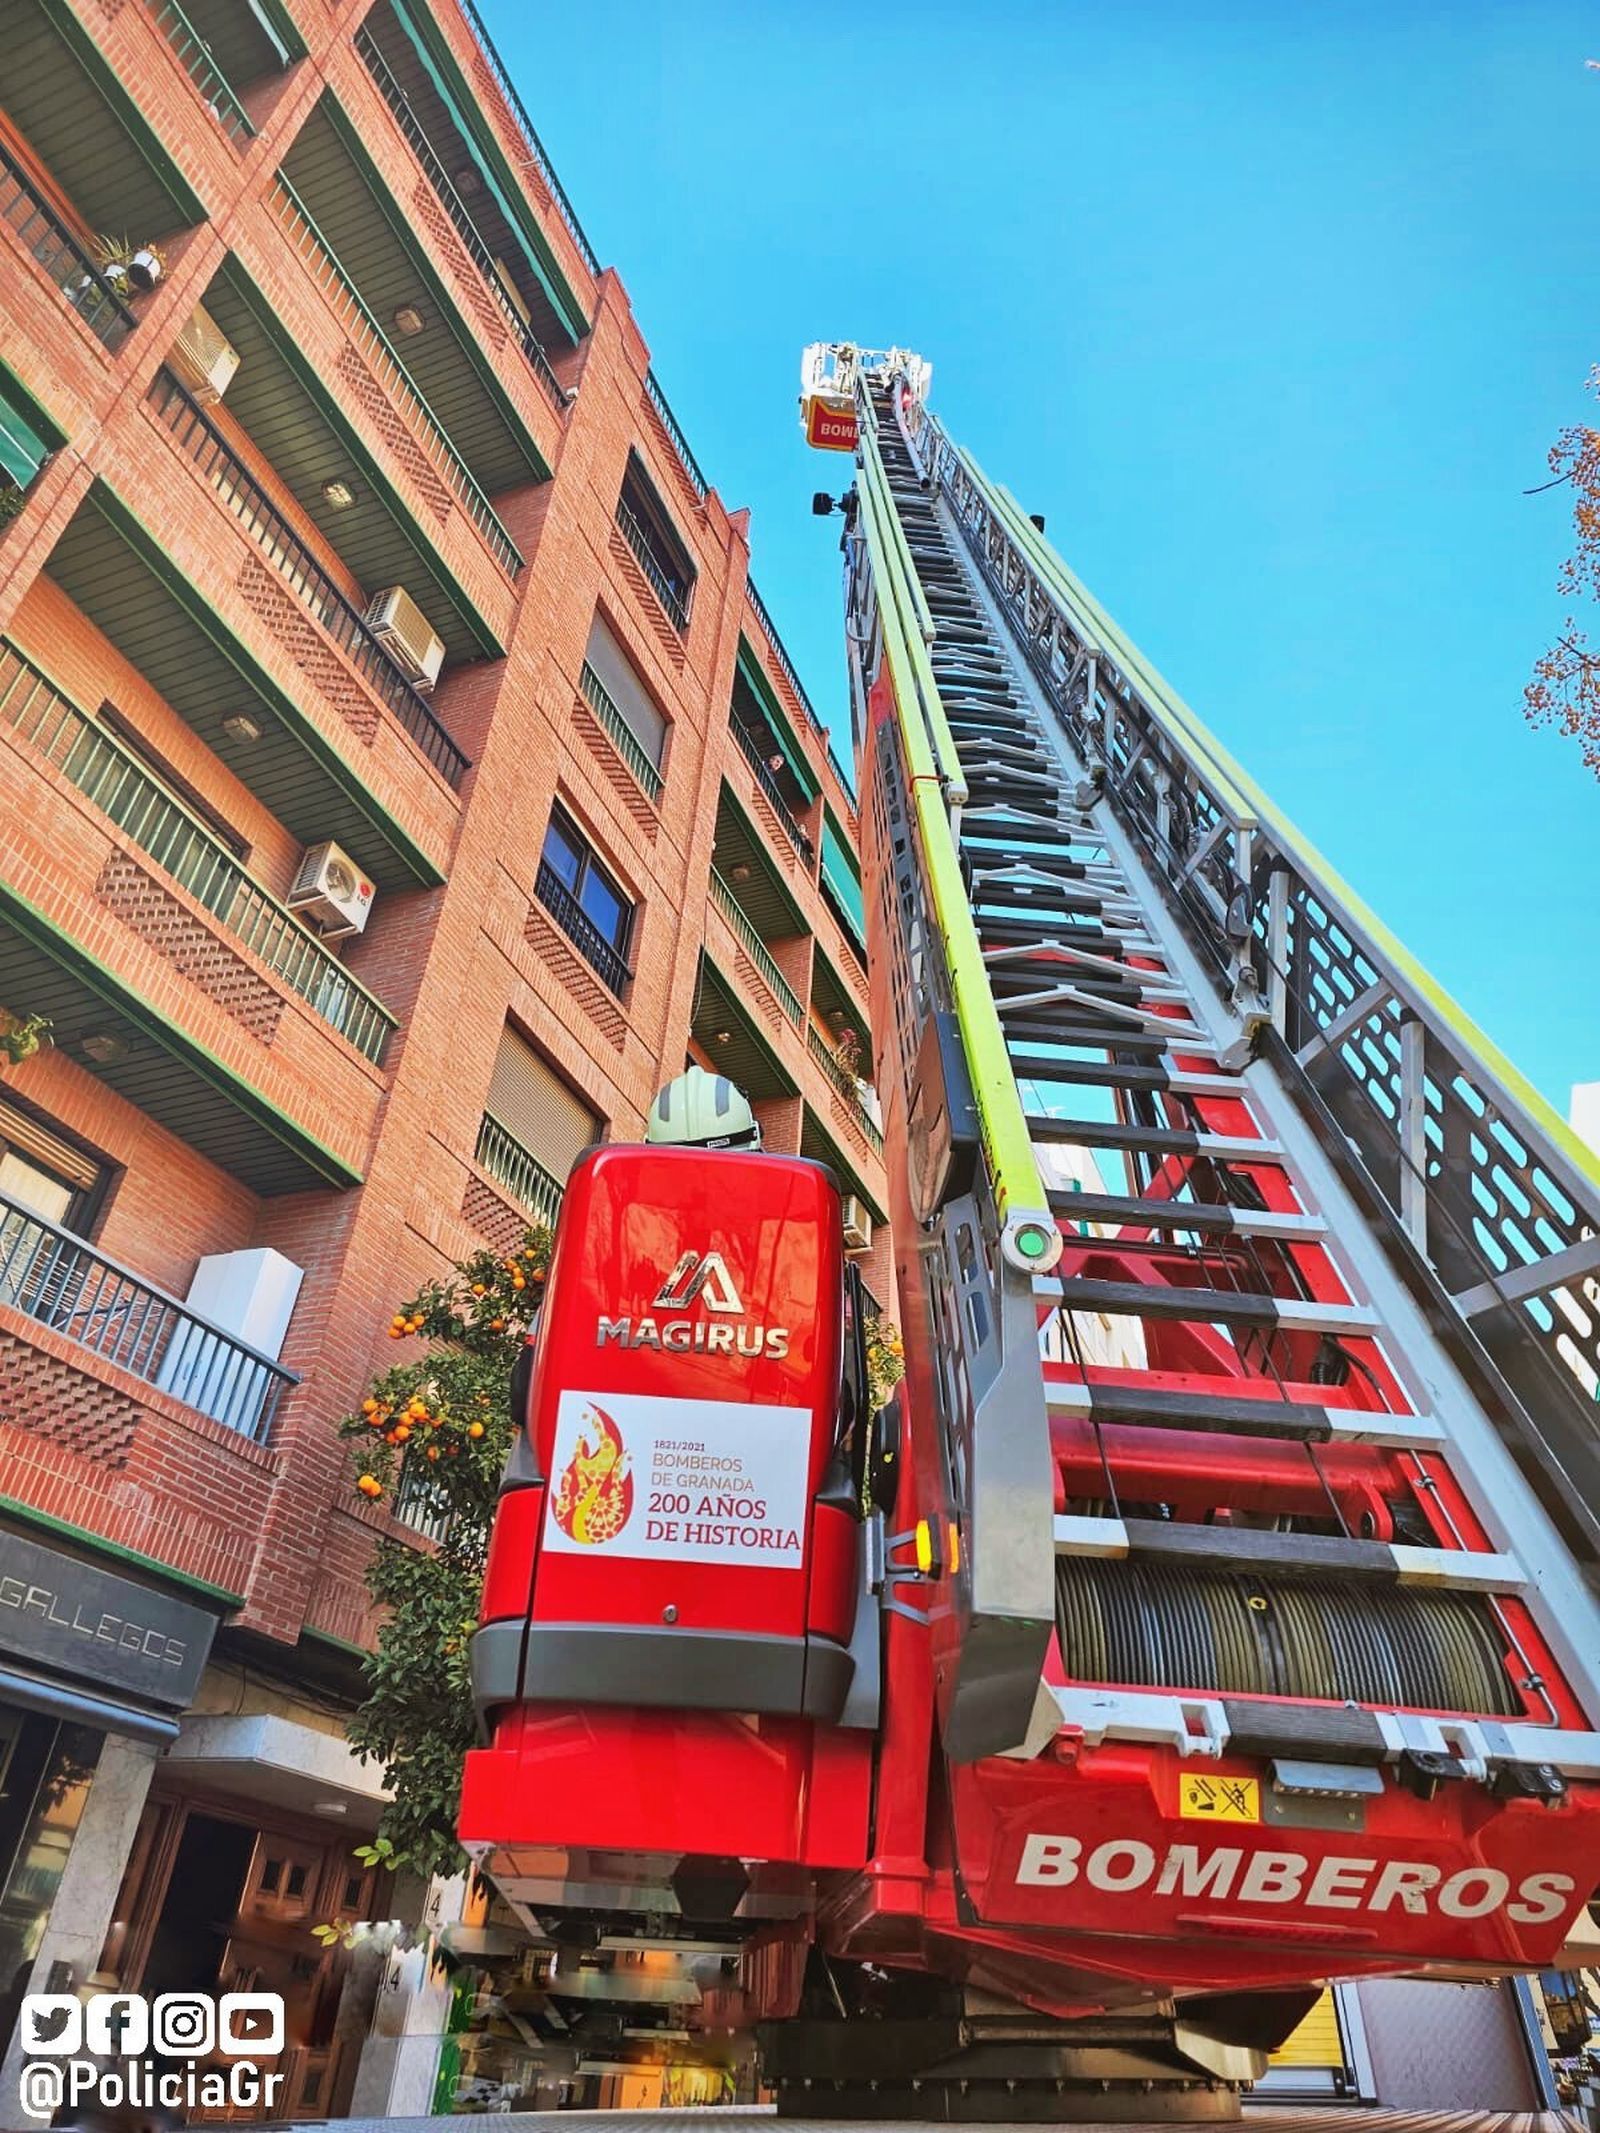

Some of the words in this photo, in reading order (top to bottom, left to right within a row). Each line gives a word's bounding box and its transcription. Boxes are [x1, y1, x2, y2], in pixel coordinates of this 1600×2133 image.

[598, 1316, 788, 1359] MAGIRUS
[653, 1439, 705, 1452] 1821/2021
[652, 1453, 743, 1473] BOMBEROS
[651, 1472, 673, 1487] DE
[676, 1473, 754, 1492] GRANADA
[648, 1493, 690, 1514] 200
[695, 1492, 767, 1519] AÑOS
[645, 1520, 680, 1541] DE
[684, 1522, 801, 1550] HISTORIA
[0, 1576, 188, 1667] GALLEGOS
[1015, 1833, 1576, 1925] BOMBEROS
